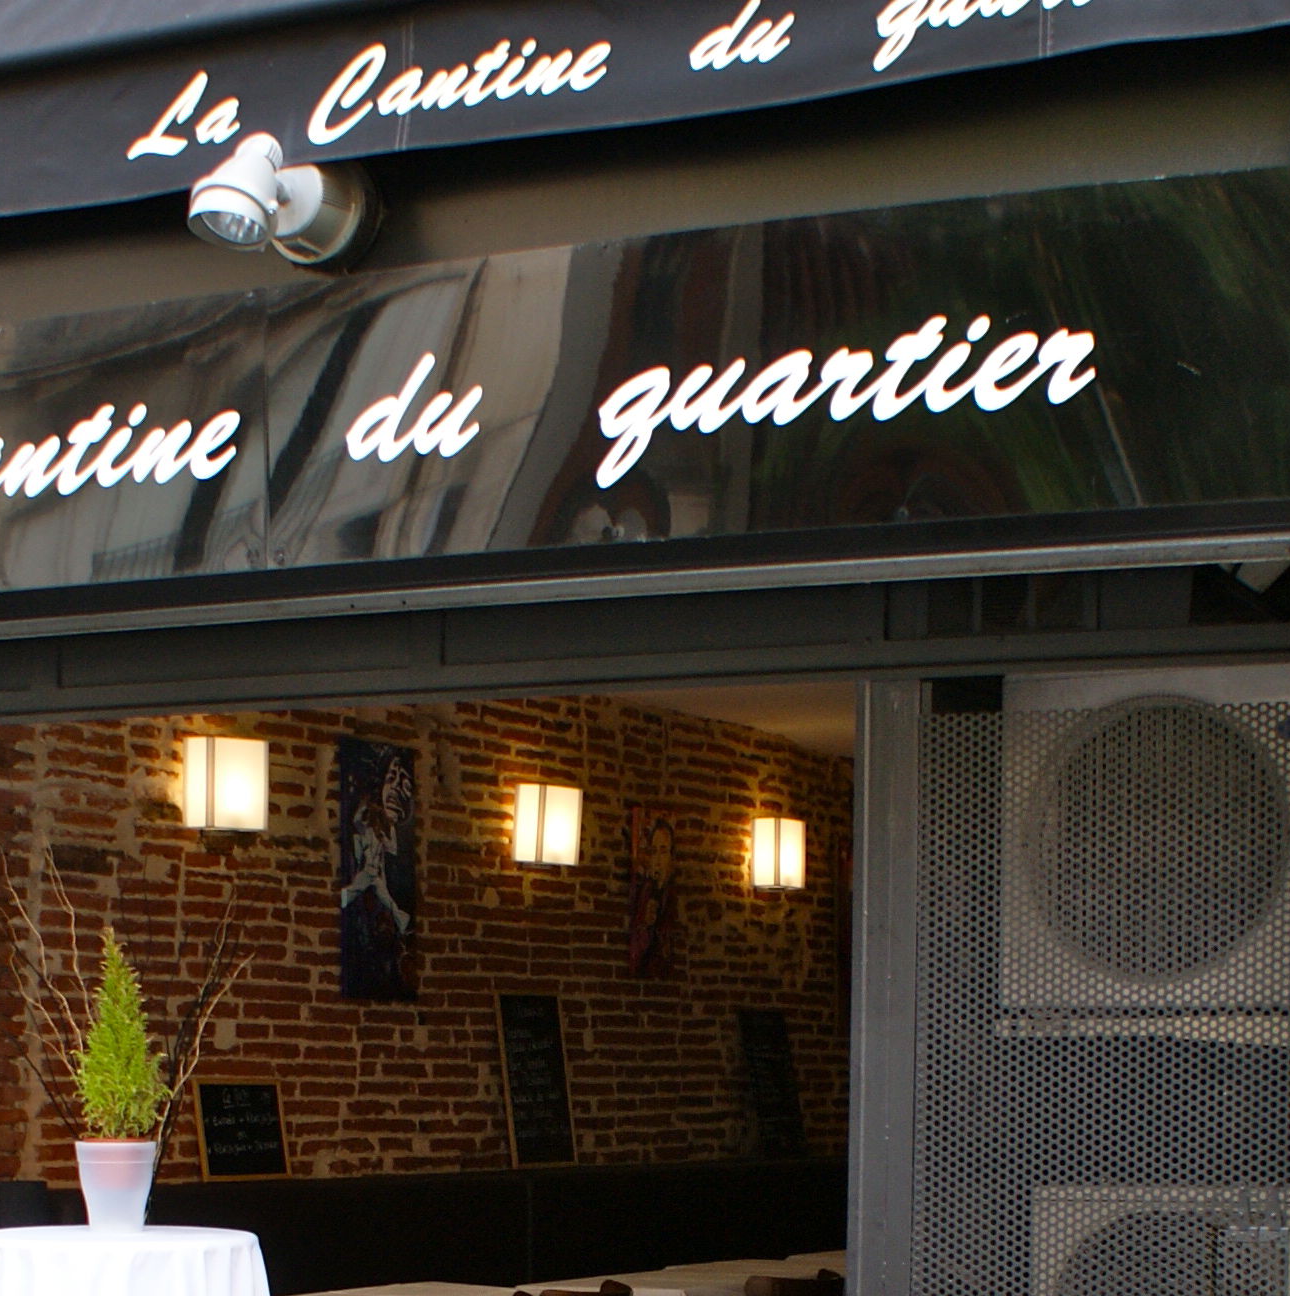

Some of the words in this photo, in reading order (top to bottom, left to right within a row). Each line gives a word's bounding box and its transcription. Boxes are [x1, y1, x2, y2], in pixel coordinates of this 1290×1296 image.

[127, 70, 240, 160] La
[308, 37, 612, 146] Cantine
[688, 0, 795, 70] du
[345, 352, 483, 463] du
[598, 314, 1097, 490] quartier
